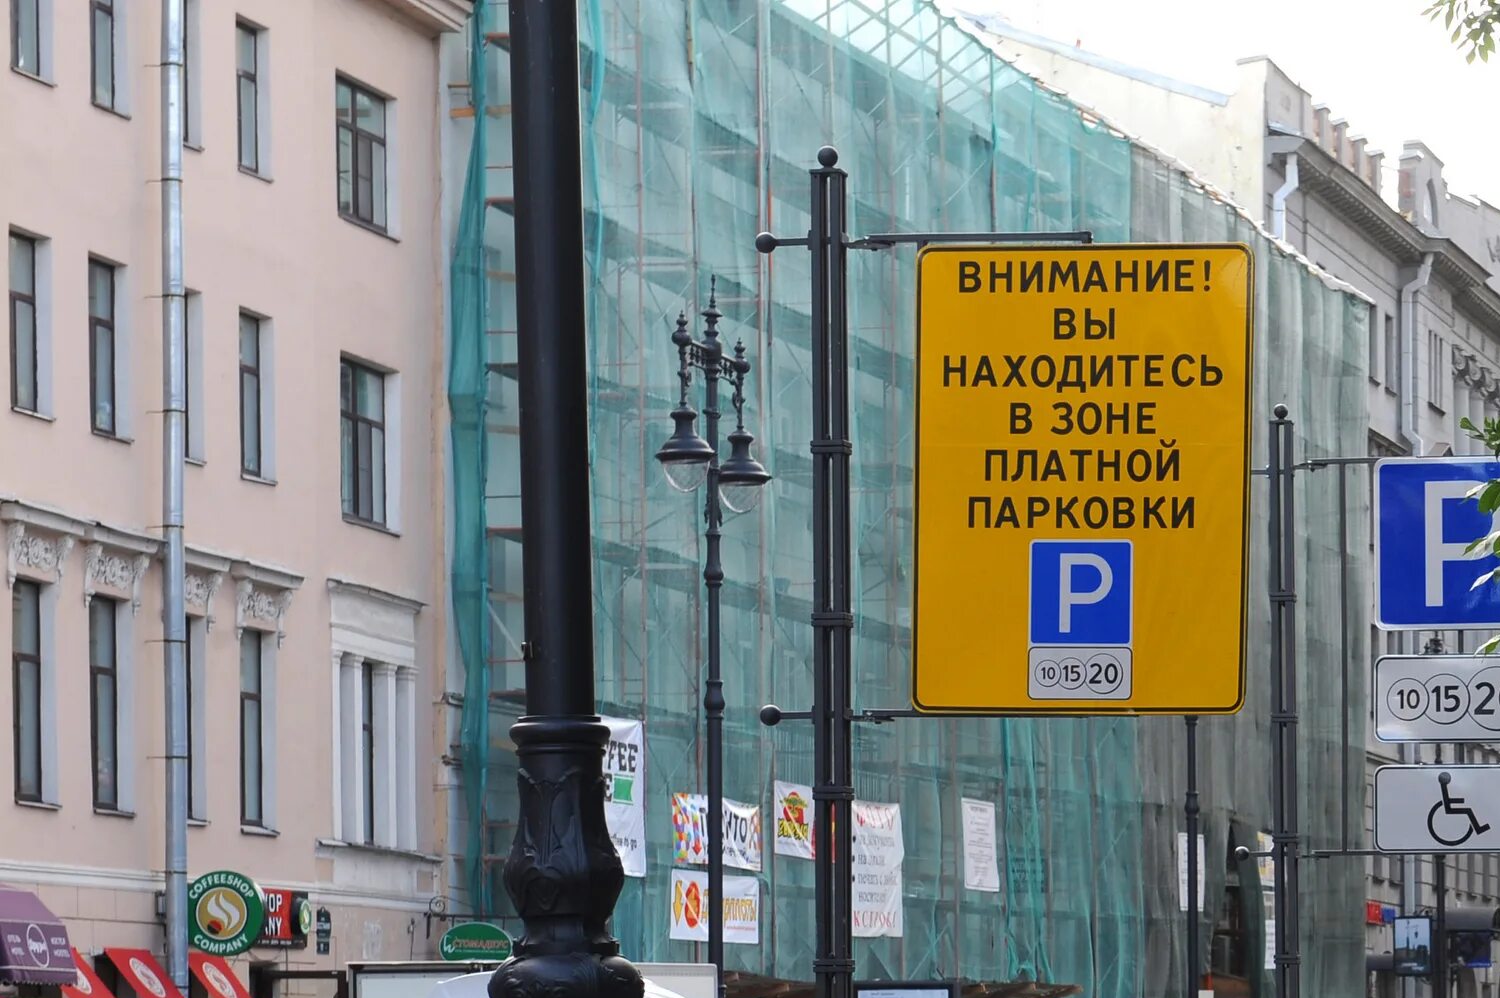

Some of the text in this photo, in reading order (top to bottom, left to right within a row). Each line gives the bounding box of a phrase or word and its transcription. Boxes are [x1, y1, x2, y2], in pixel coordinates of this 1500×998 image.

[958, 260, 1211, 294] ВНИМАНИЕ!
[1053, 308, 1115, 340] ВЫ
[942, 354, 1223, 393] НАХОДИТЕСЬ
[1009, 402, 1156, 435] В ЗОНЕ
[984, 439, 1181, 482] ПЛАТНОЙ
[967, 496, 1195, 529] ПАРКОВКИ
[1059, 553, 1114, 633] P
[1041, 662, 1119, 686] 10 15 20
[1396, 688, 1420, 710] 10
[1430, 685, 1461, 713] 15
[189, 873, 255, 899] COFFEESHOP
[194, 934, 249, 953] COMPANY
